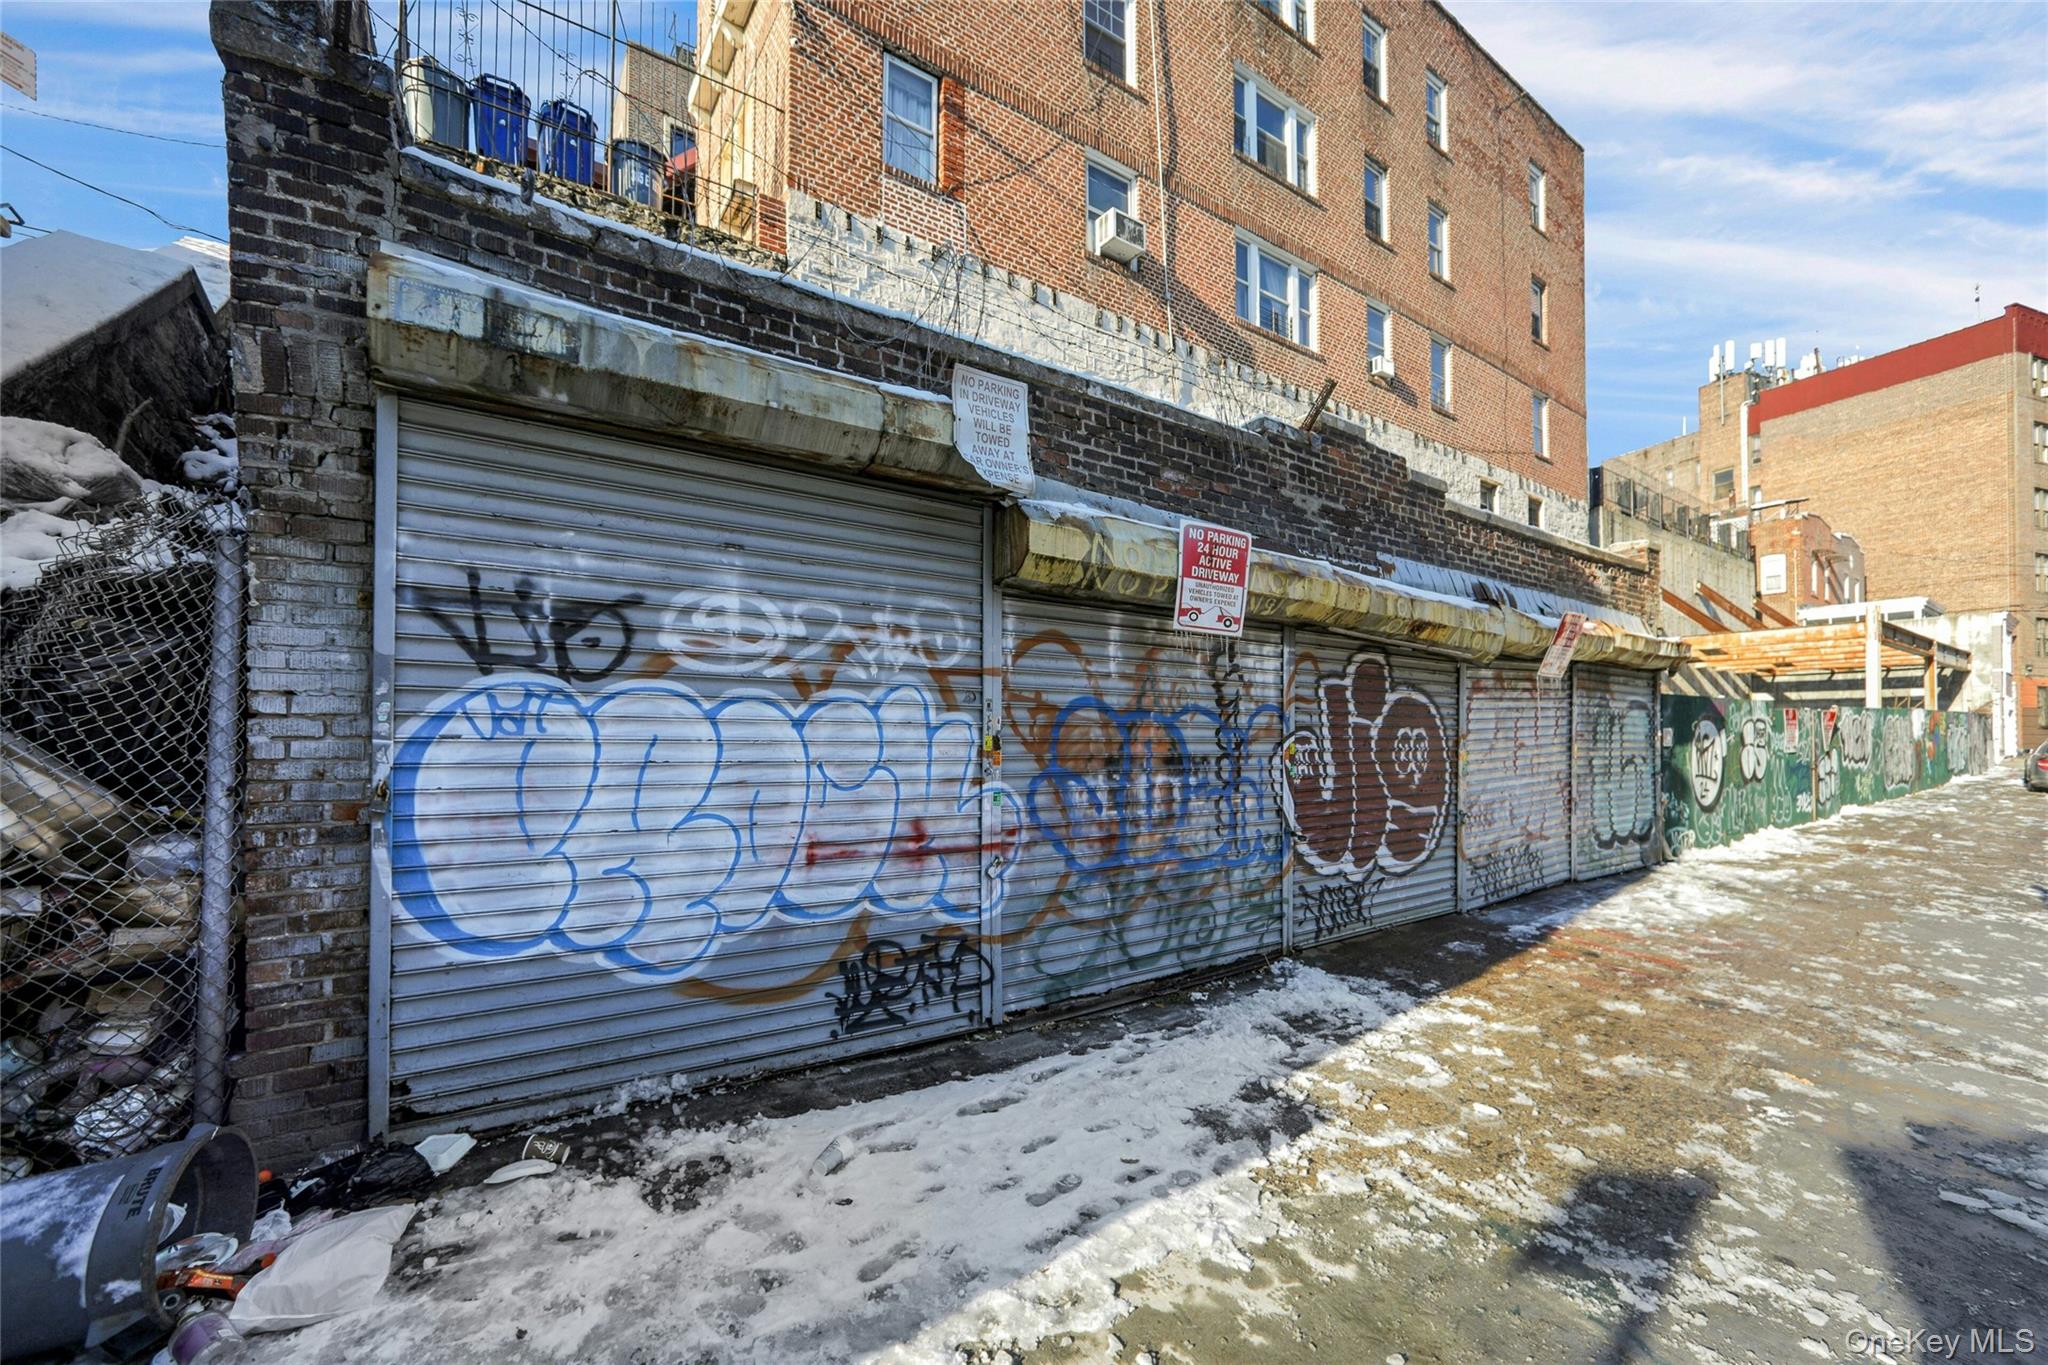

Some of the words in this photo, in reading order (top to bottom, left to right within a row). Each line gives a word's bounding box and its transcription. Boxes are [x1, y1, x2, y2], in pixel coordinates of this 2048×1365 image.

[960, 374, 976, 387] NO
[977, 379, 1020, 400] PARKING
[959, 388, 970, 400] IN
[972, 391, 1021, 413] DRIVEWAY
[967, 403, 1015, 423] VEHICLES
[973, 417, 996, 433] WILL
[999, 423, 1012, 436] BE
[975, 431, 1010, 448] TOWED
[971, 444, 1000, 459] AWAY
[1003, 450, 1015, 461] AT
[984, 457, 1030, 475] OWNER'S
[1188, 527, 1205, 541] NO
[1207, 530, 1247, 550] PARKING
[1197, 542, 1210, 554] 24
[1211, 545, 1239, 560] HOUR
[1199, 555, 1232, 571] ACTIVE
[1191, 565, 1240, 584] DRIVEWAY
[1188, 587, 1213, 598] VEHICLES
[1213, 591, 1233, 601] TOWED
[1194, 581, 1235, 593] UNAUTHORIZED
[126, 1166, 163, 1221] BRUTE
